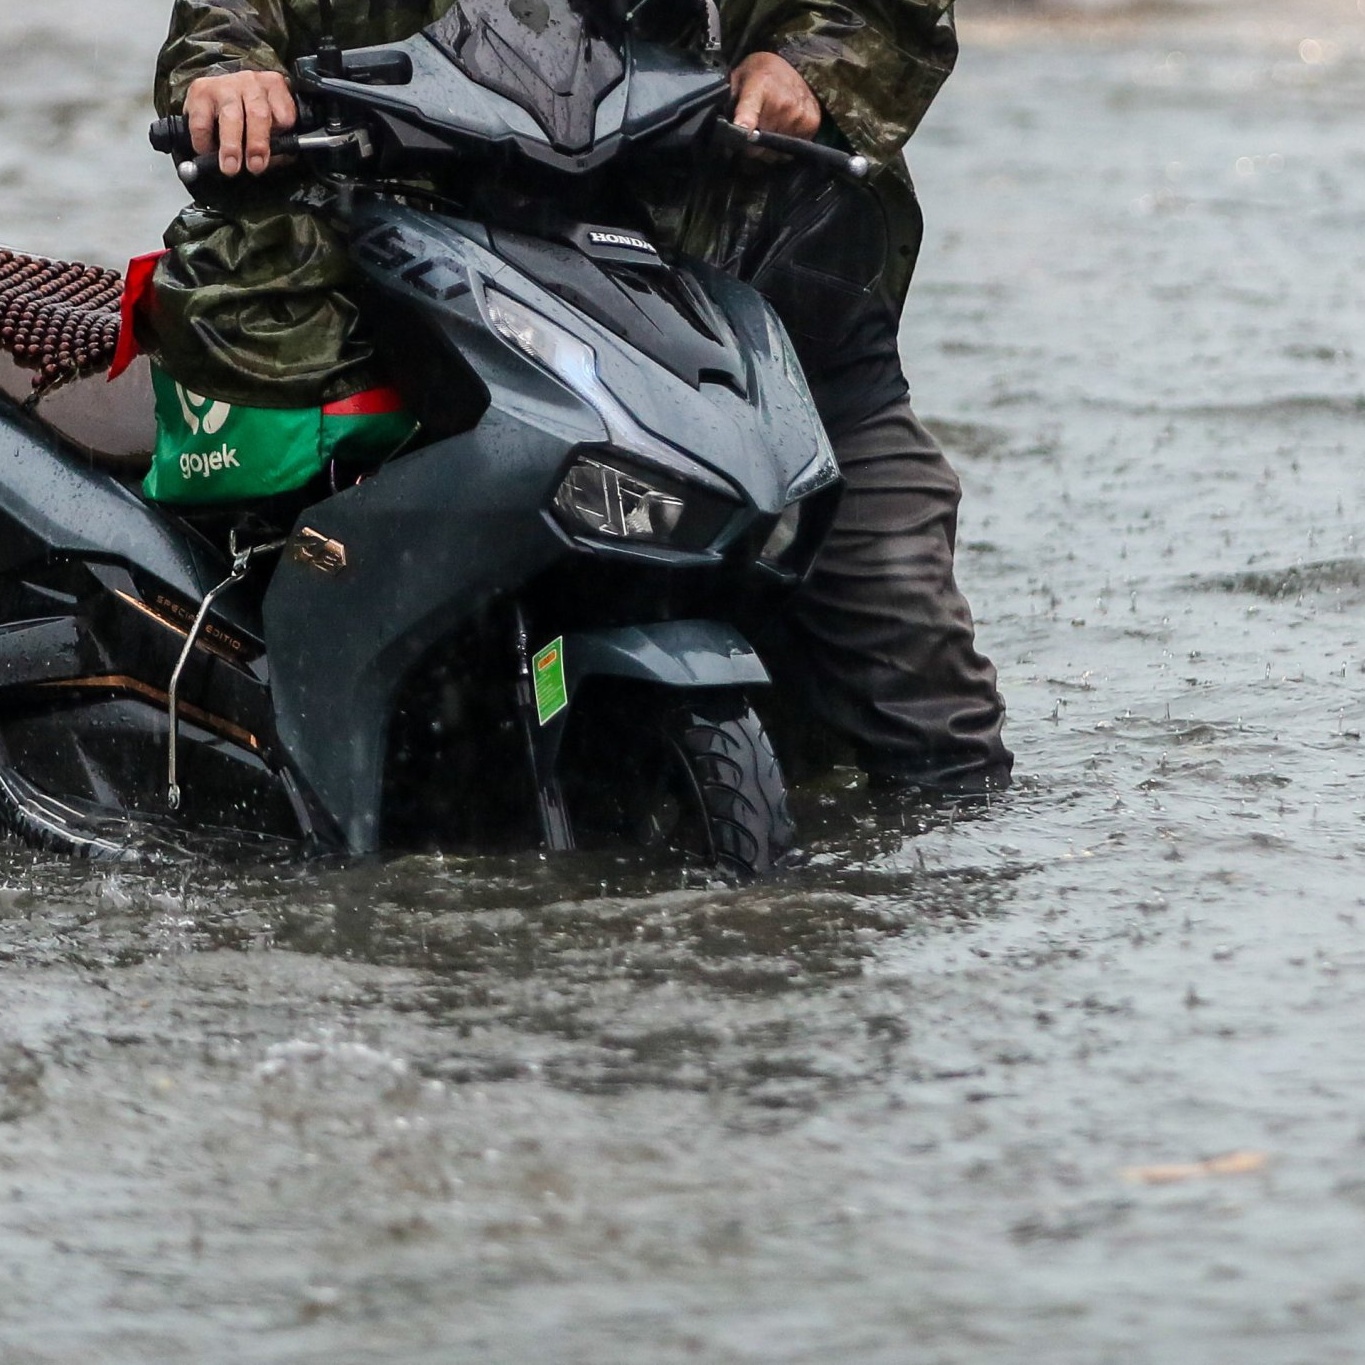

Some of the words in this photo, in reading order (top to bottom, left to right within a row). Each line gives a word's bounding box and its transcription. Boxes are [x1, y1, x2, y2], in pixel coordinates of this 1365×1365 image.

[589, 232, 657, 253] HONDA
[180, 443, 240, 479] gojek
[156, 595, 197, 622] SPECIA
[205, 624, 242, 650] EDITIO
